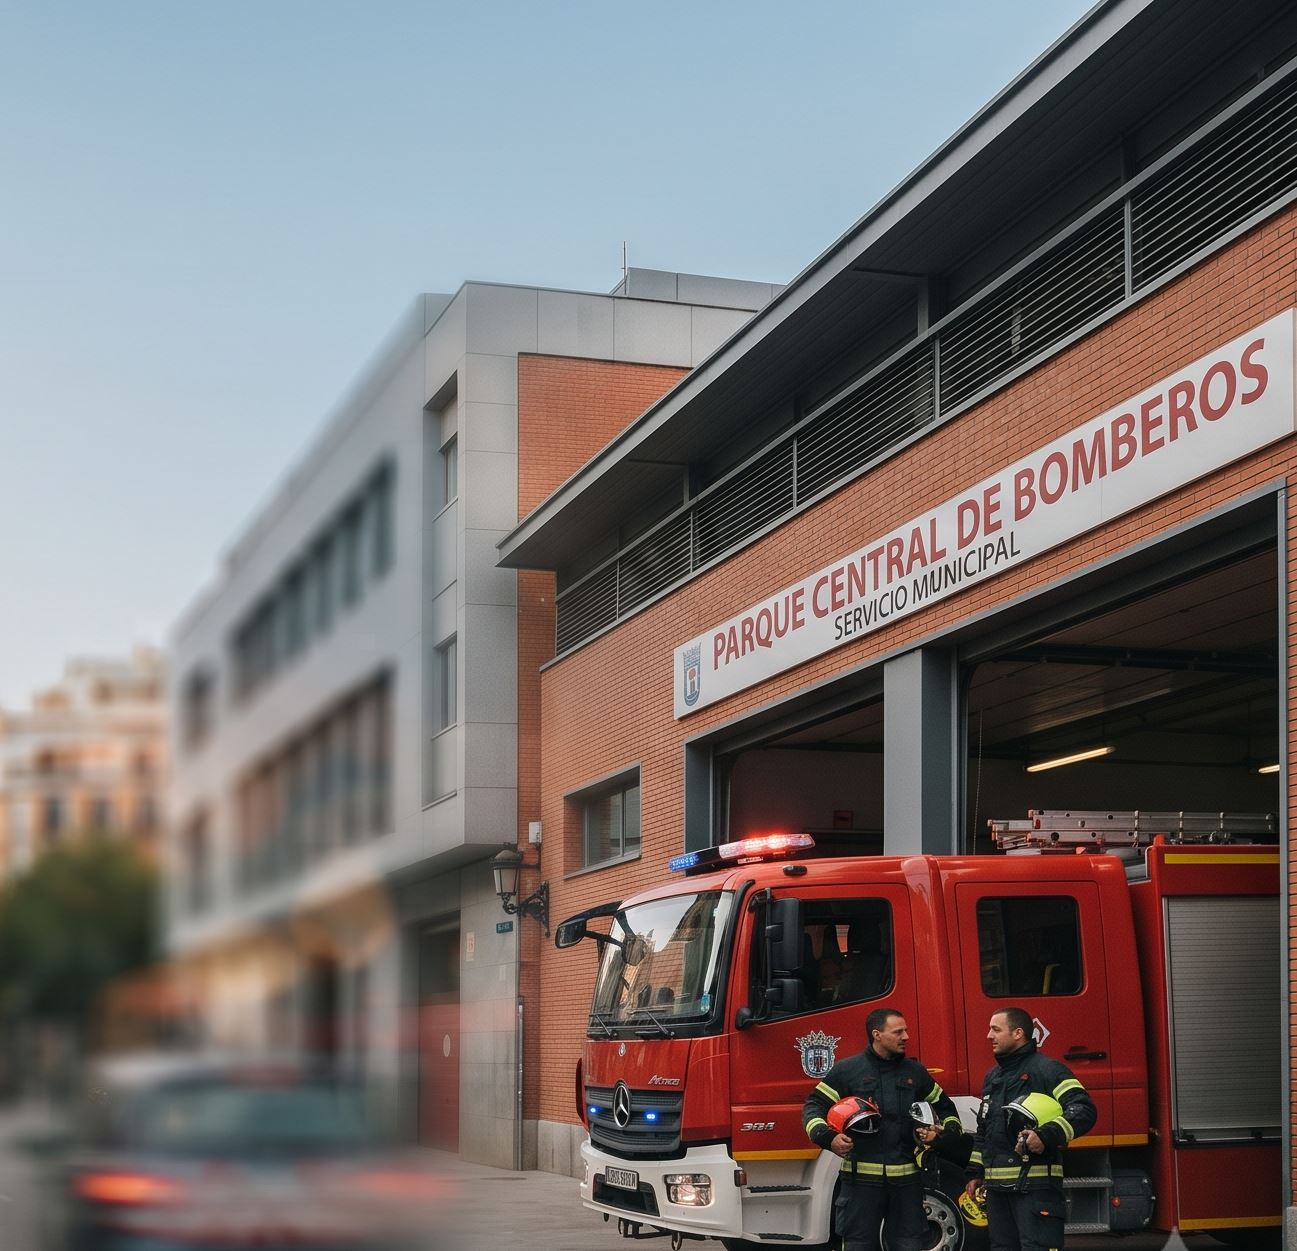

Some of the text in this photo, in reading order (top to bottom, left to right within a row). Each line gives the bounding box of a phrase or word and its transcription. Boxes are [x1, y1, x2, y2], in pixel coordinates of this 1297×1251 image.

[713, 338, 1270, 670] PARQUE CENTRAL DE BOMBEROS
[834, 531, 1021, 641] SERVICIO MUNICIPAL
